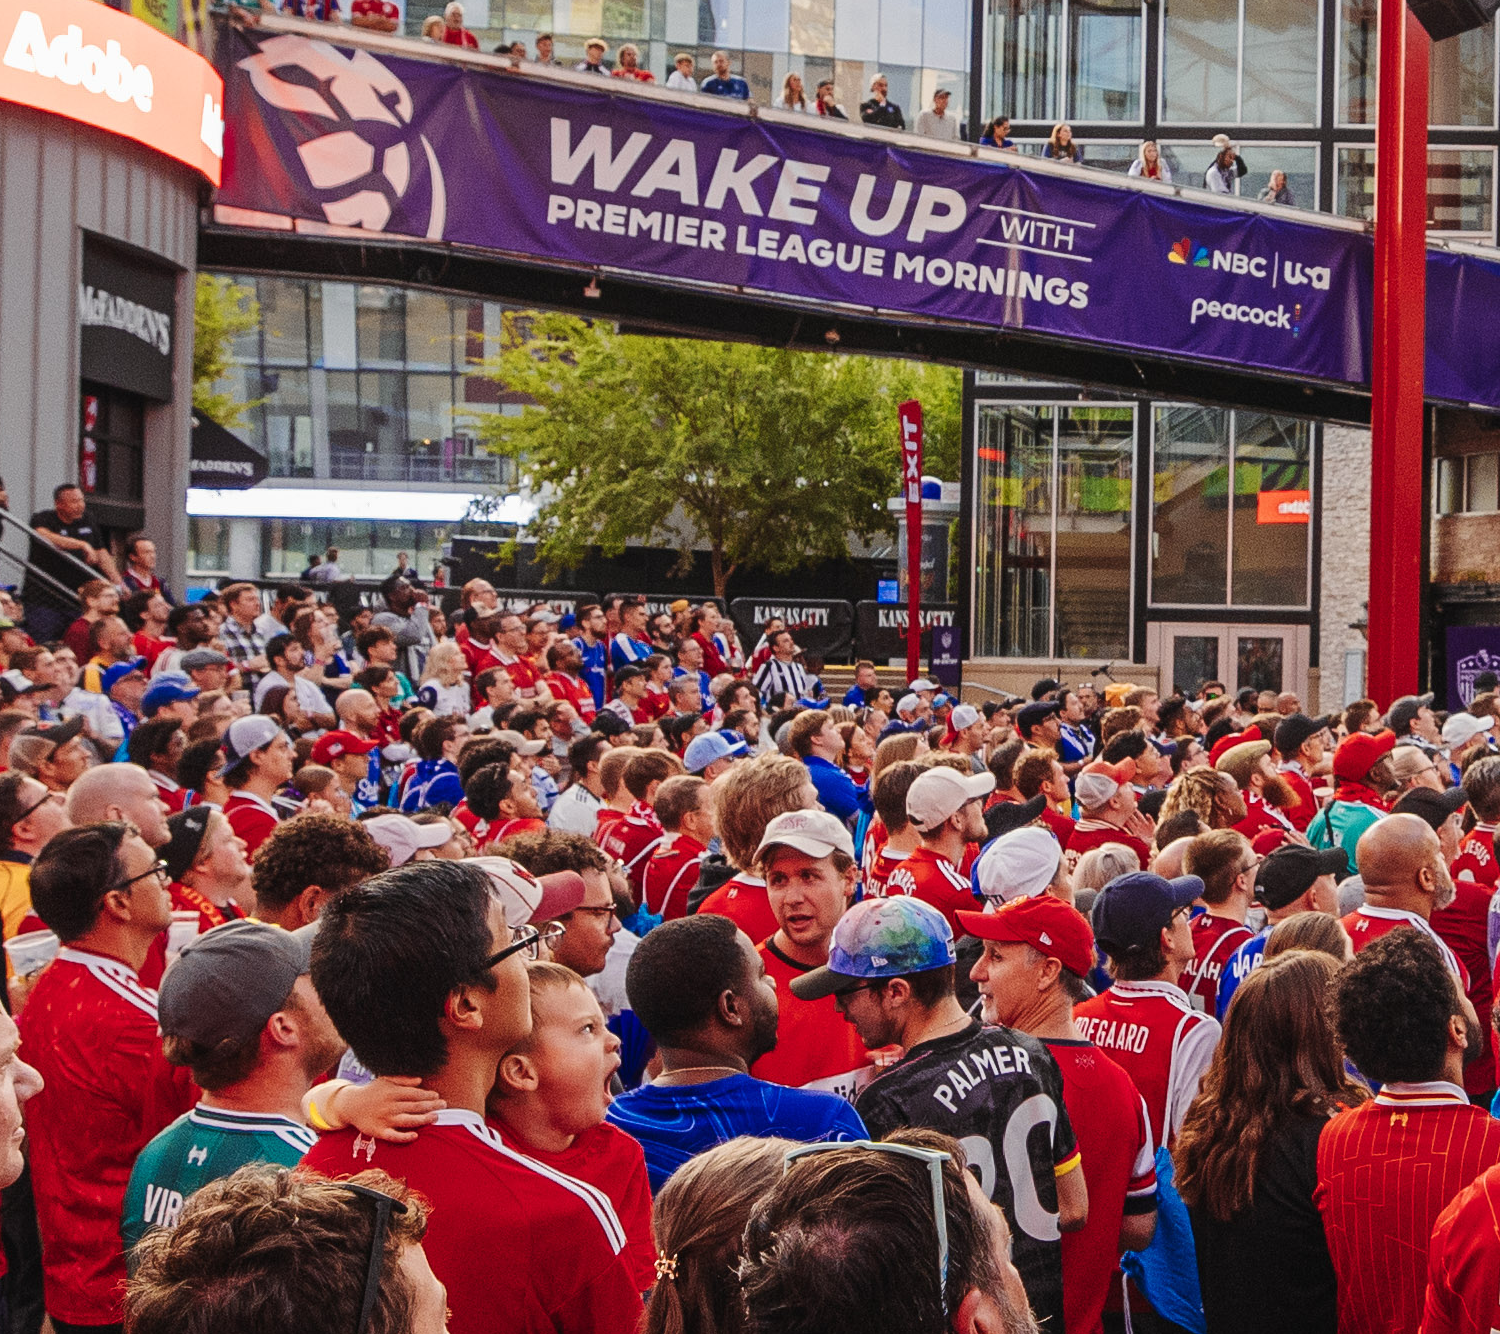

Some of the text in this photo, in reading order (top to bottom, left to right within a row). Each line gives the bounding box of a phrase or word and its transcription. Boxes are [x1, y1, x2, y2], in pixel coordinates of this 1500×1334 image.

[2, 10, 154, 113] Adobe
[549, 116, 968, 243] WAKE UP
[546, 194, 1091, 311] PREMIER LEAGUE MORNINGS
[999, 213, 1076, 253] WITH
[1211, 249, 1267, 279] NBC
[1189, 296, 1292, 331] peacock
[902, 414, 921, 504] EXIT
[877, 608, 926, 628] KANSS
[933, 1044, 1031, 1113] PALMER
